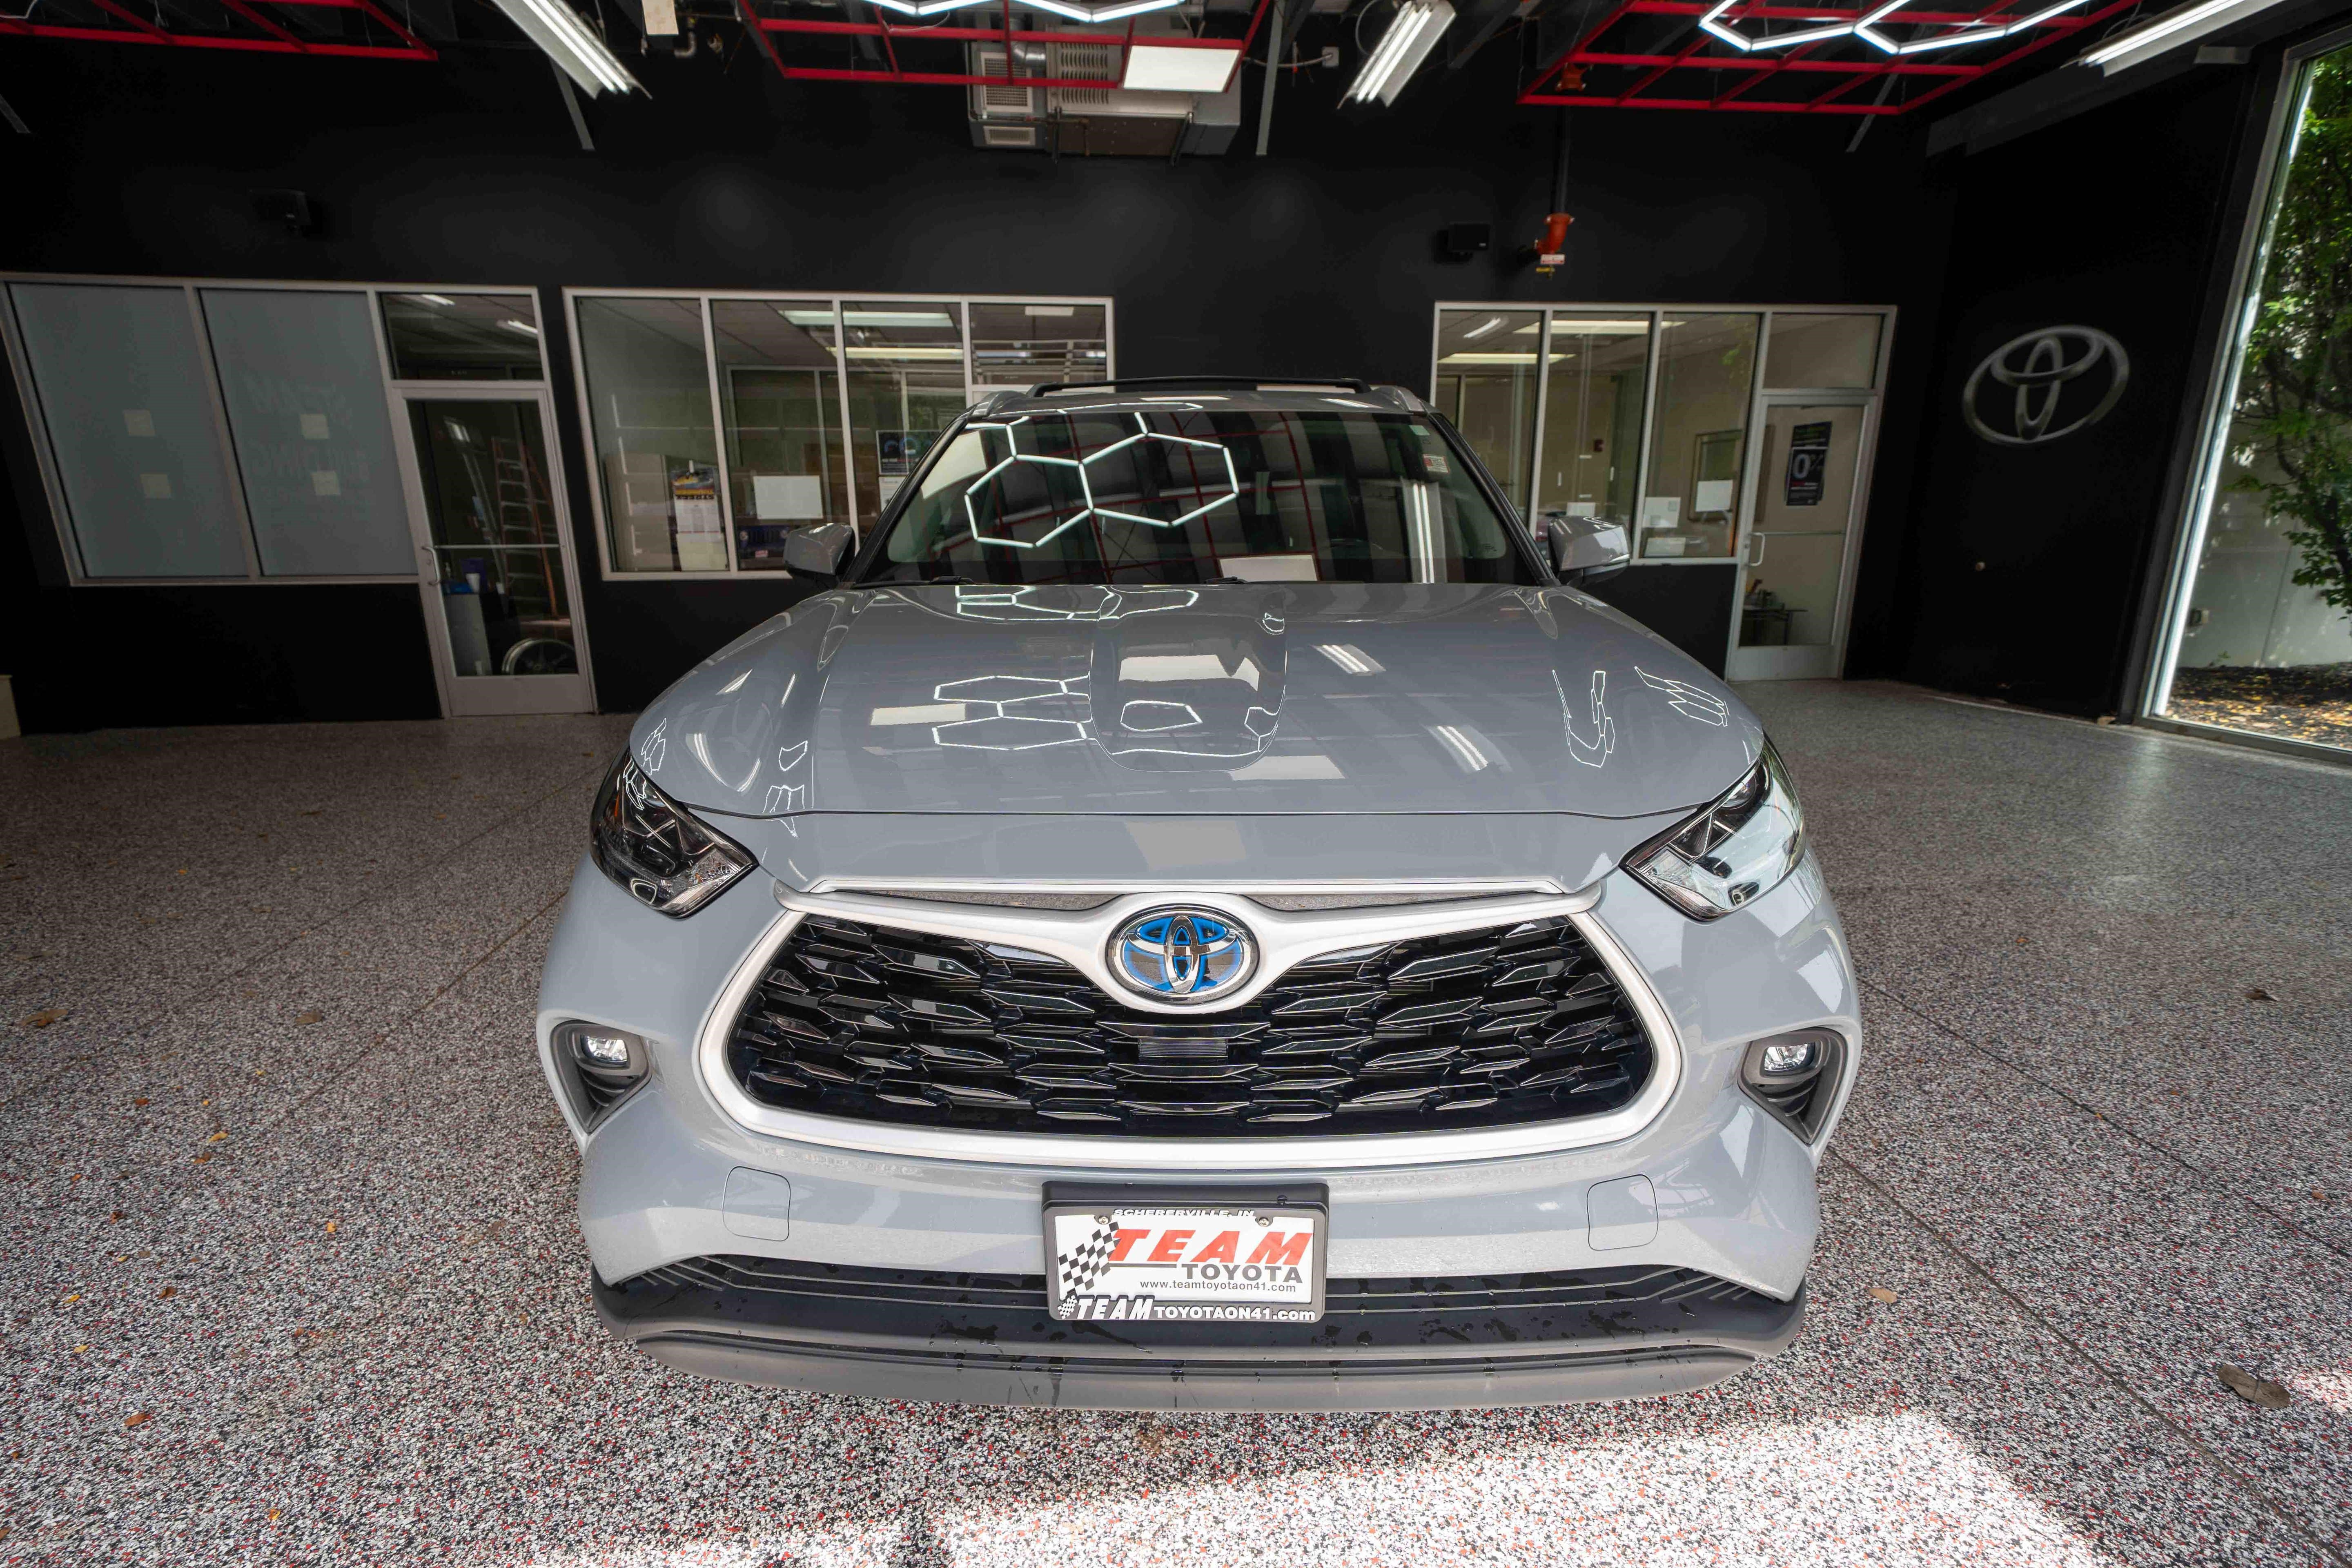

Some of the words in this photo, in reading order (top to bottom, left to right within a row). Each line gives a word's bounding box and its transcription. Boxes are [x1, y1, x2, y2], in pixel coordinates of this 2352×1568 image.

[1108, 1229, 1313, 1265] TEAM
[1181, 1264, 1303, 1283] TOYOTA
[1140, 1280, 1296, 1292] www.teamtoyotaon41.com
[1076, 1298, 1154, 1320] TEAM
[1154, 1306, 1316, 1321] TOYOTAON41.com
